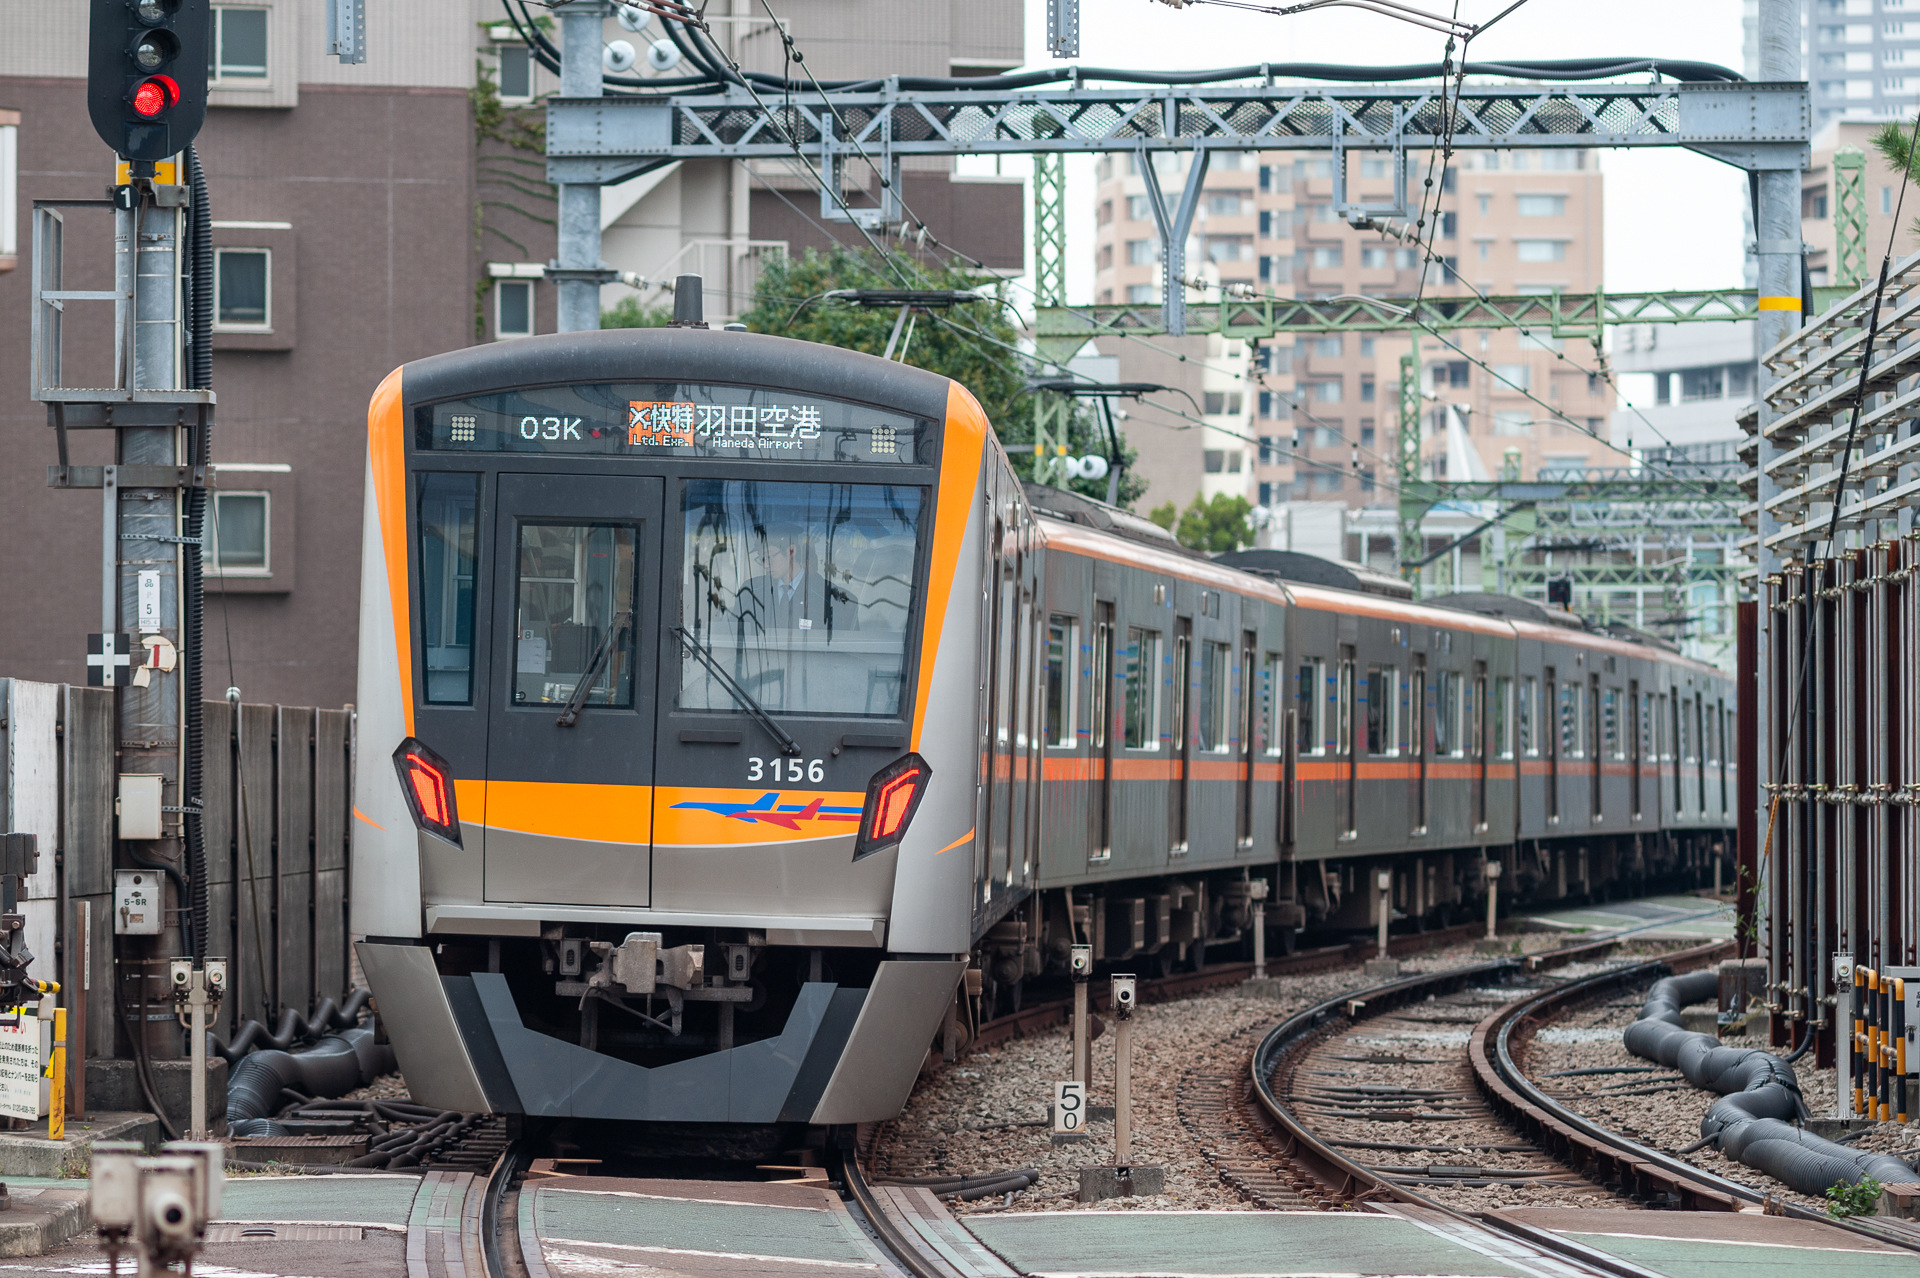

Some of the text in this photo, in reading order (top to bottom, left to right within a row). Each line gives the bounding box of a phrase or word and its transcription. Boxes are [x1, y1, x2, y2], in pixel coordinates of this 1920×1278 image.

[120, 187, 131, 208] 1
[520, 416, 582, 441] 03K
[651, 403, 821, 440] 快特 羽田空港
[633, 434, 689, 447] Ltd. Exp.
[712, 436, 803, 450] Haneda Airport
[146, 604, 152, 614] 5
[747, 757, 825, 783] 3156
[1060, 1085, 1081, 1111] 5
[1064, 1112, 1077, 1130] 0
